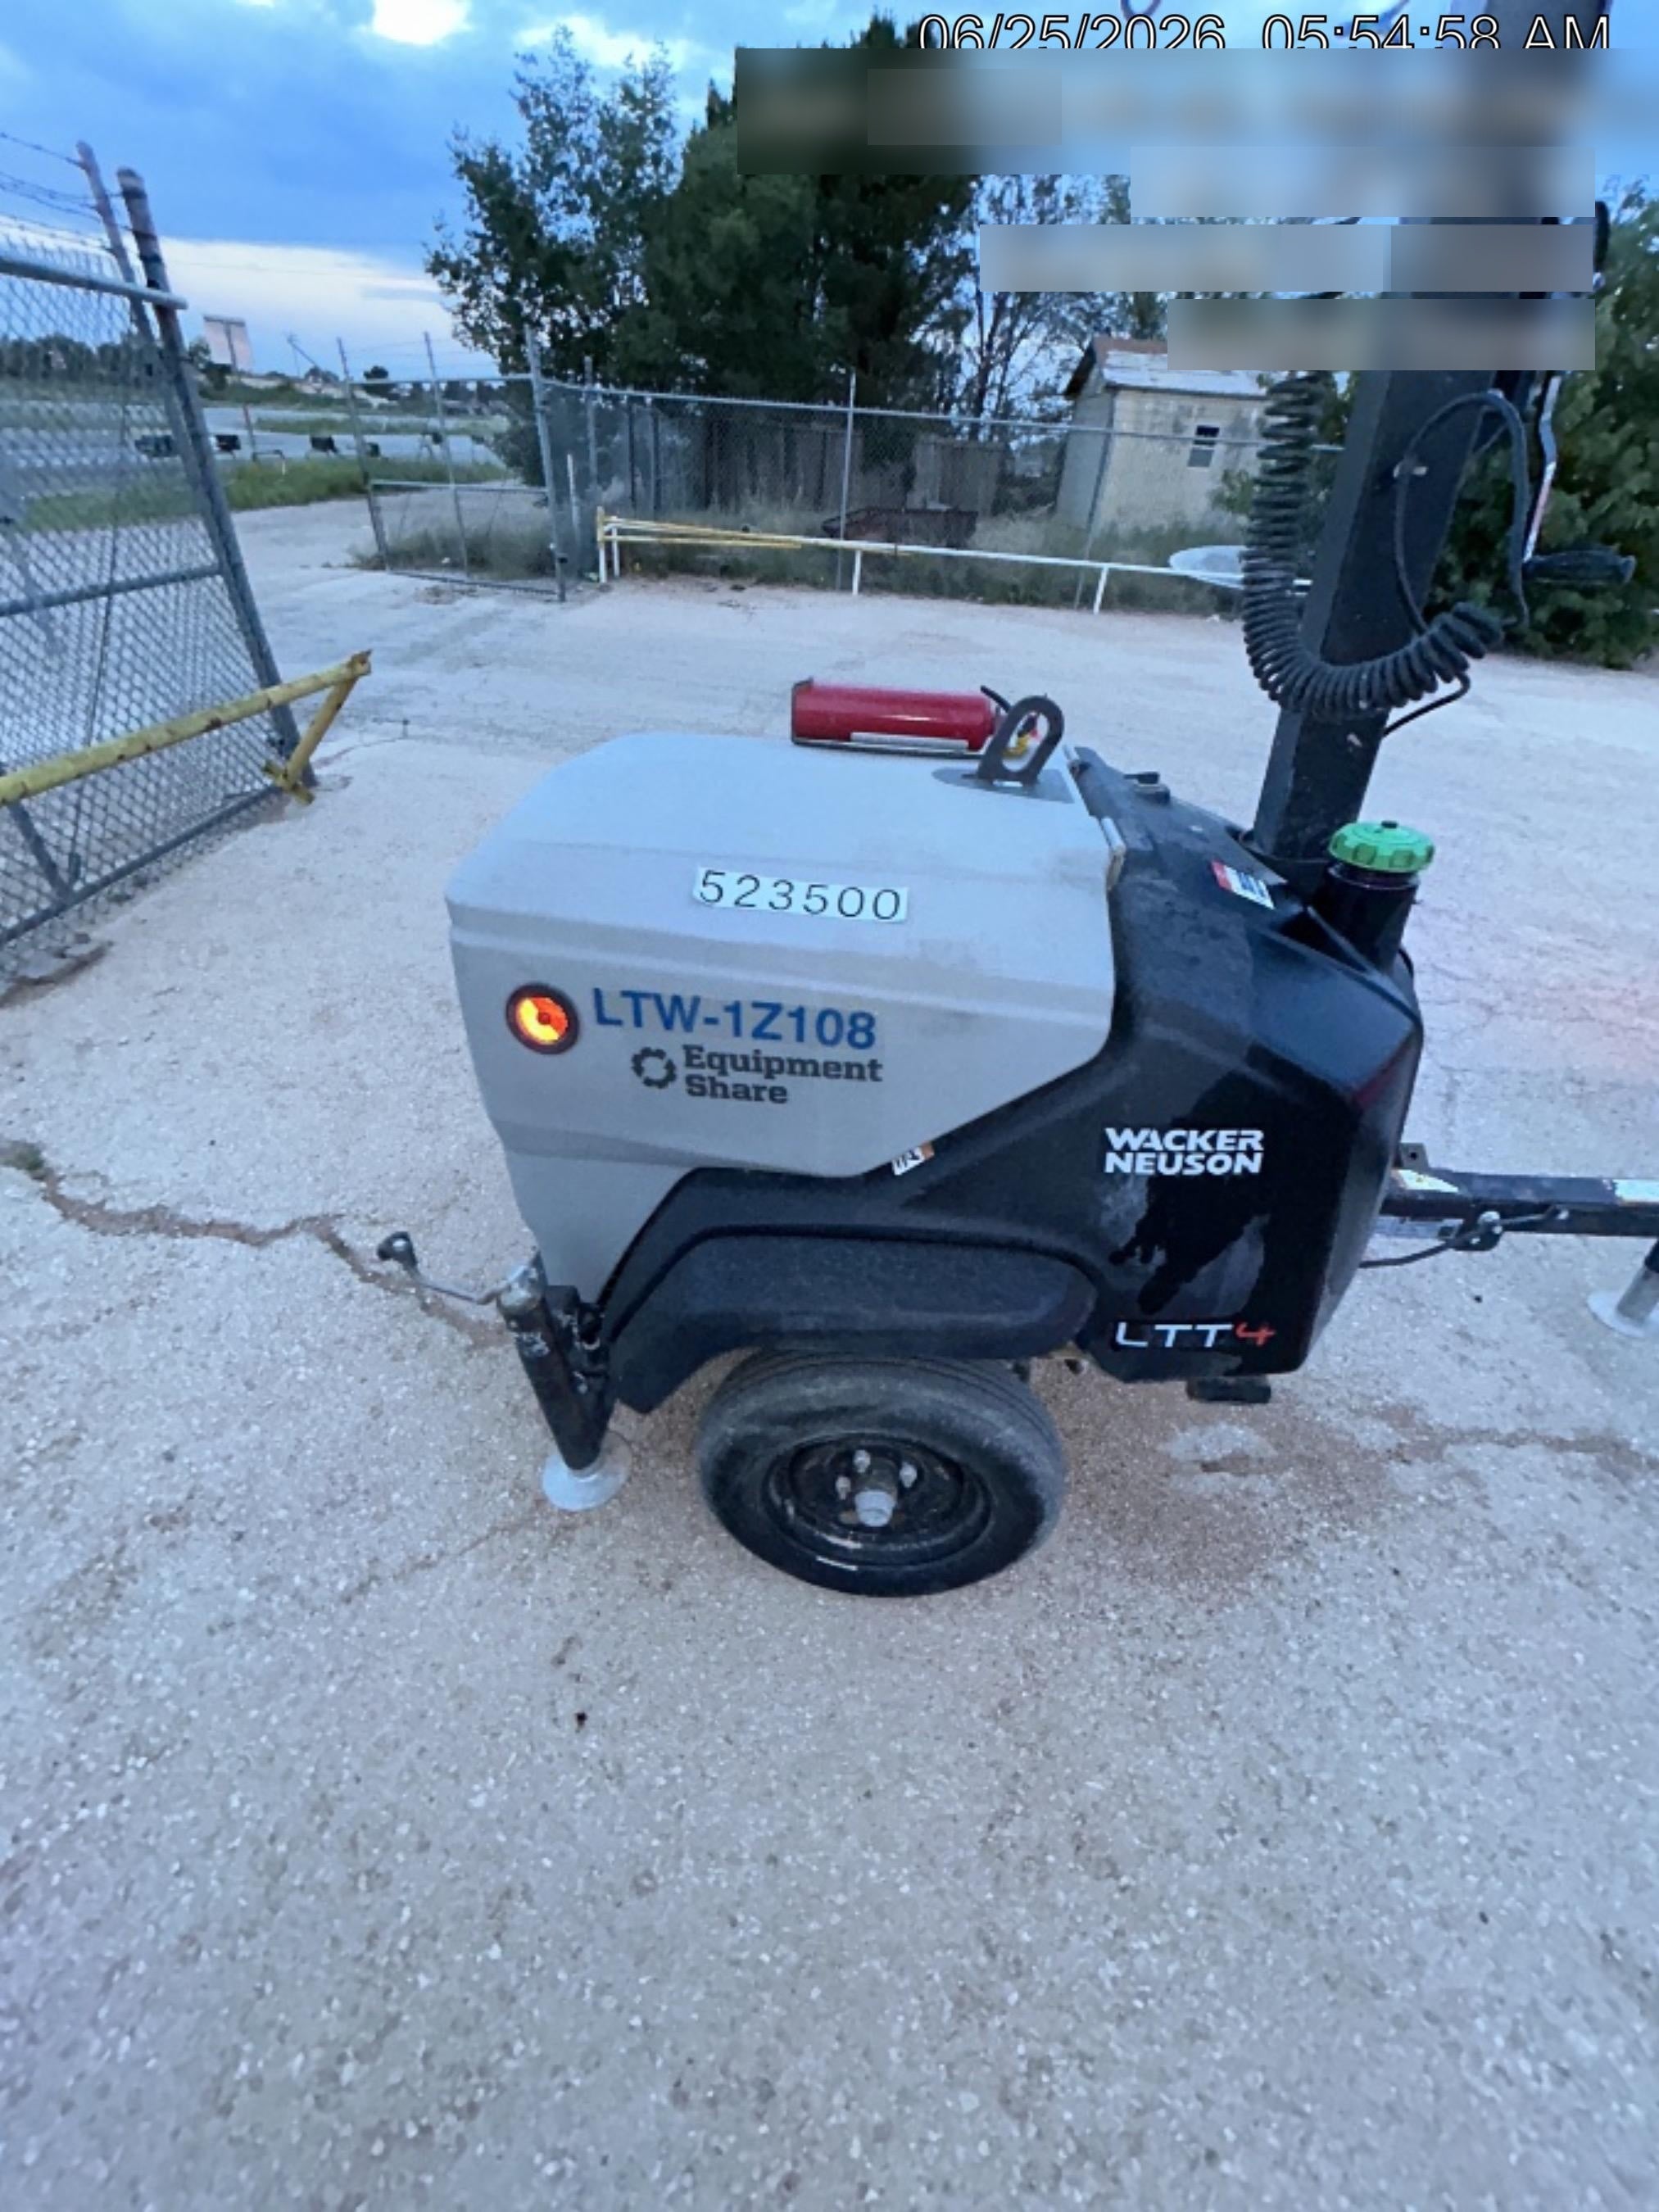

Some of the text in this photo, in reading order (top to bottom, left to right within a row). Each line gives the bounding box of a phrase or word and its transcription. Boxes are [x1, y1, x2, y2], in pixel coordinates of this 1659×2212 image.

[699, 869, 900, 919] 523500
[593, 987, 877, 1049] LTW-1Z108
[683, 1045, 883, 1082] Equipment
[687, 1075, 788, 1104] Share
[1104, 1127, 1264, 1151] WACKER
[1104, 1152, 1262, 1175] NEUSON
[1115, 1321, 1276, 1348] LTT4
